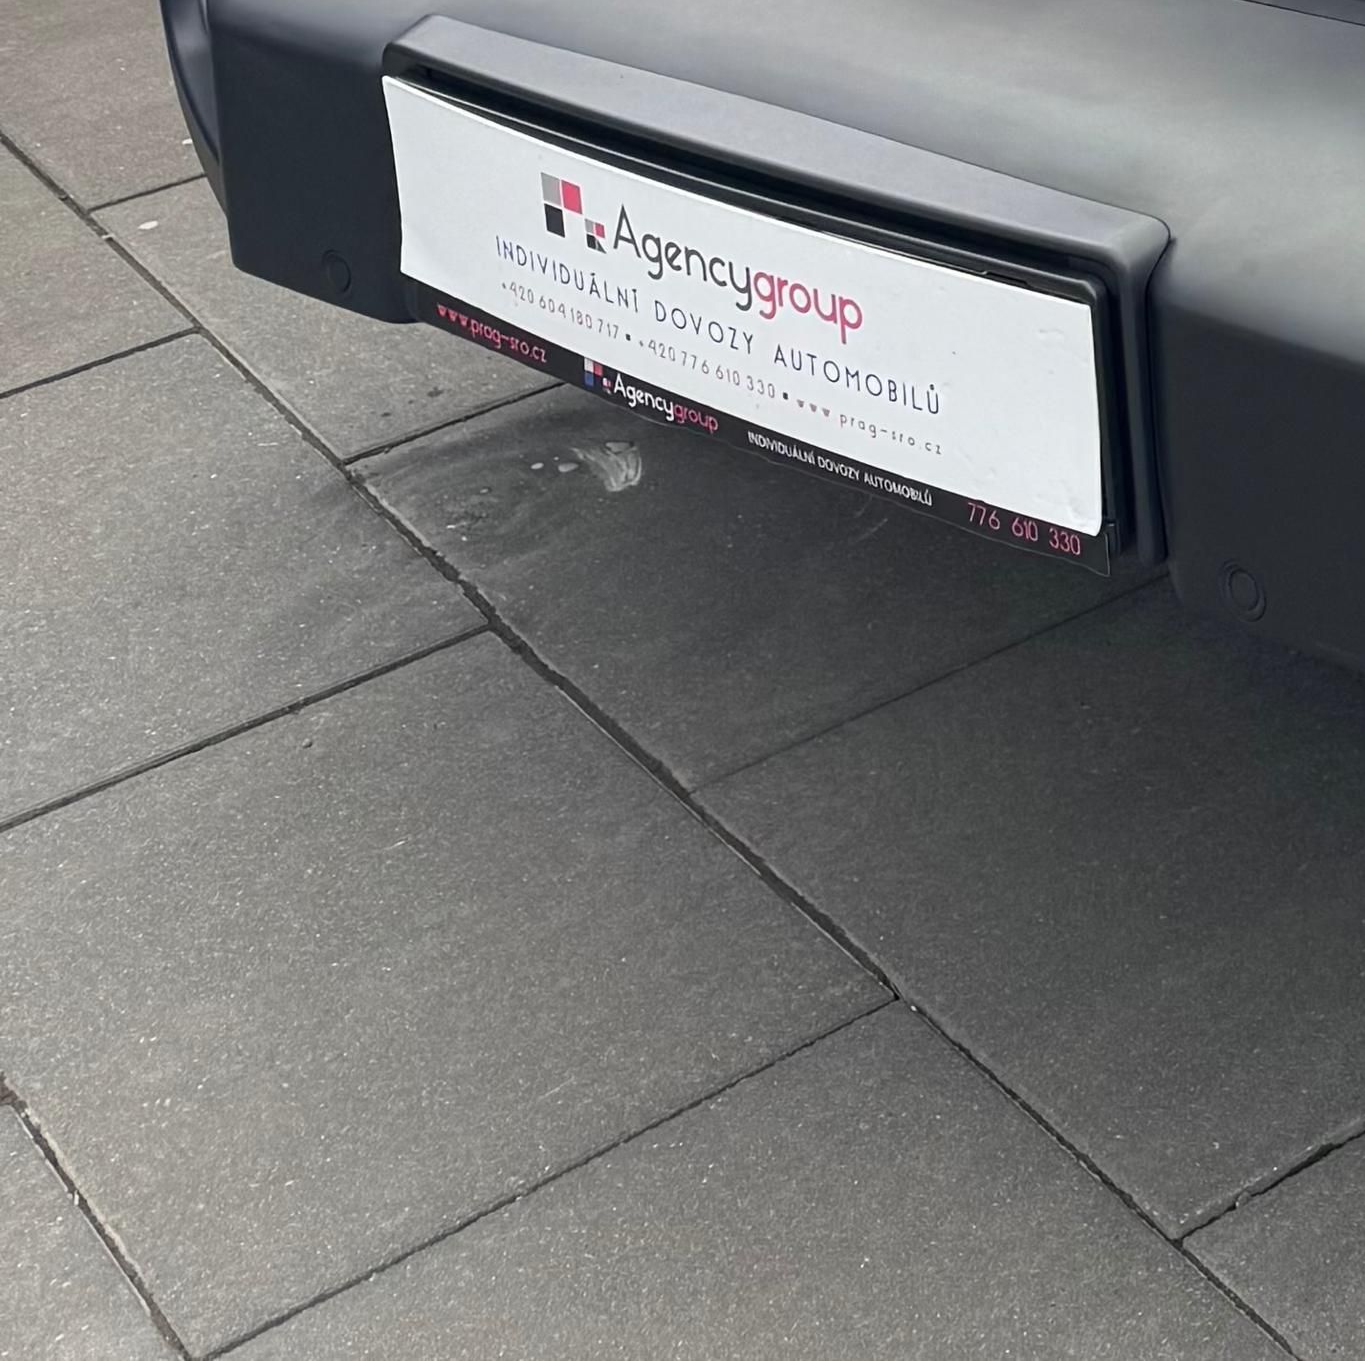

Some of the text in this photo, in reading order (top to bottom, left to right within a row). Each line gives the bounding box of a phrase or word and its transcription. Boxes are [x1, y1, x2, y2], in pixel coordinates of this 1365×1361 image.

[613, 204, 863, 343] Agencygroup
[496, 235, 940, 415] INDIVIDUÁLNÍ DOVOZY AUTOMOBILŮ
[539, 295, 567, 319] 604
[571, 307, 593, 329] 180
[597, 318, 619, 339] 717
[680, 350, 710, 375] 776
[715, 364, 741, 386] 610
[746, 374, 776, 399] 330
[613, 373, 719, 434] Agencygroup
[747, 430, 933, 507] INDIVIDUÁLNÍ DOVOZY AUTOMOBILŮ
[968, 501, 1081, 555] 776 610 330
